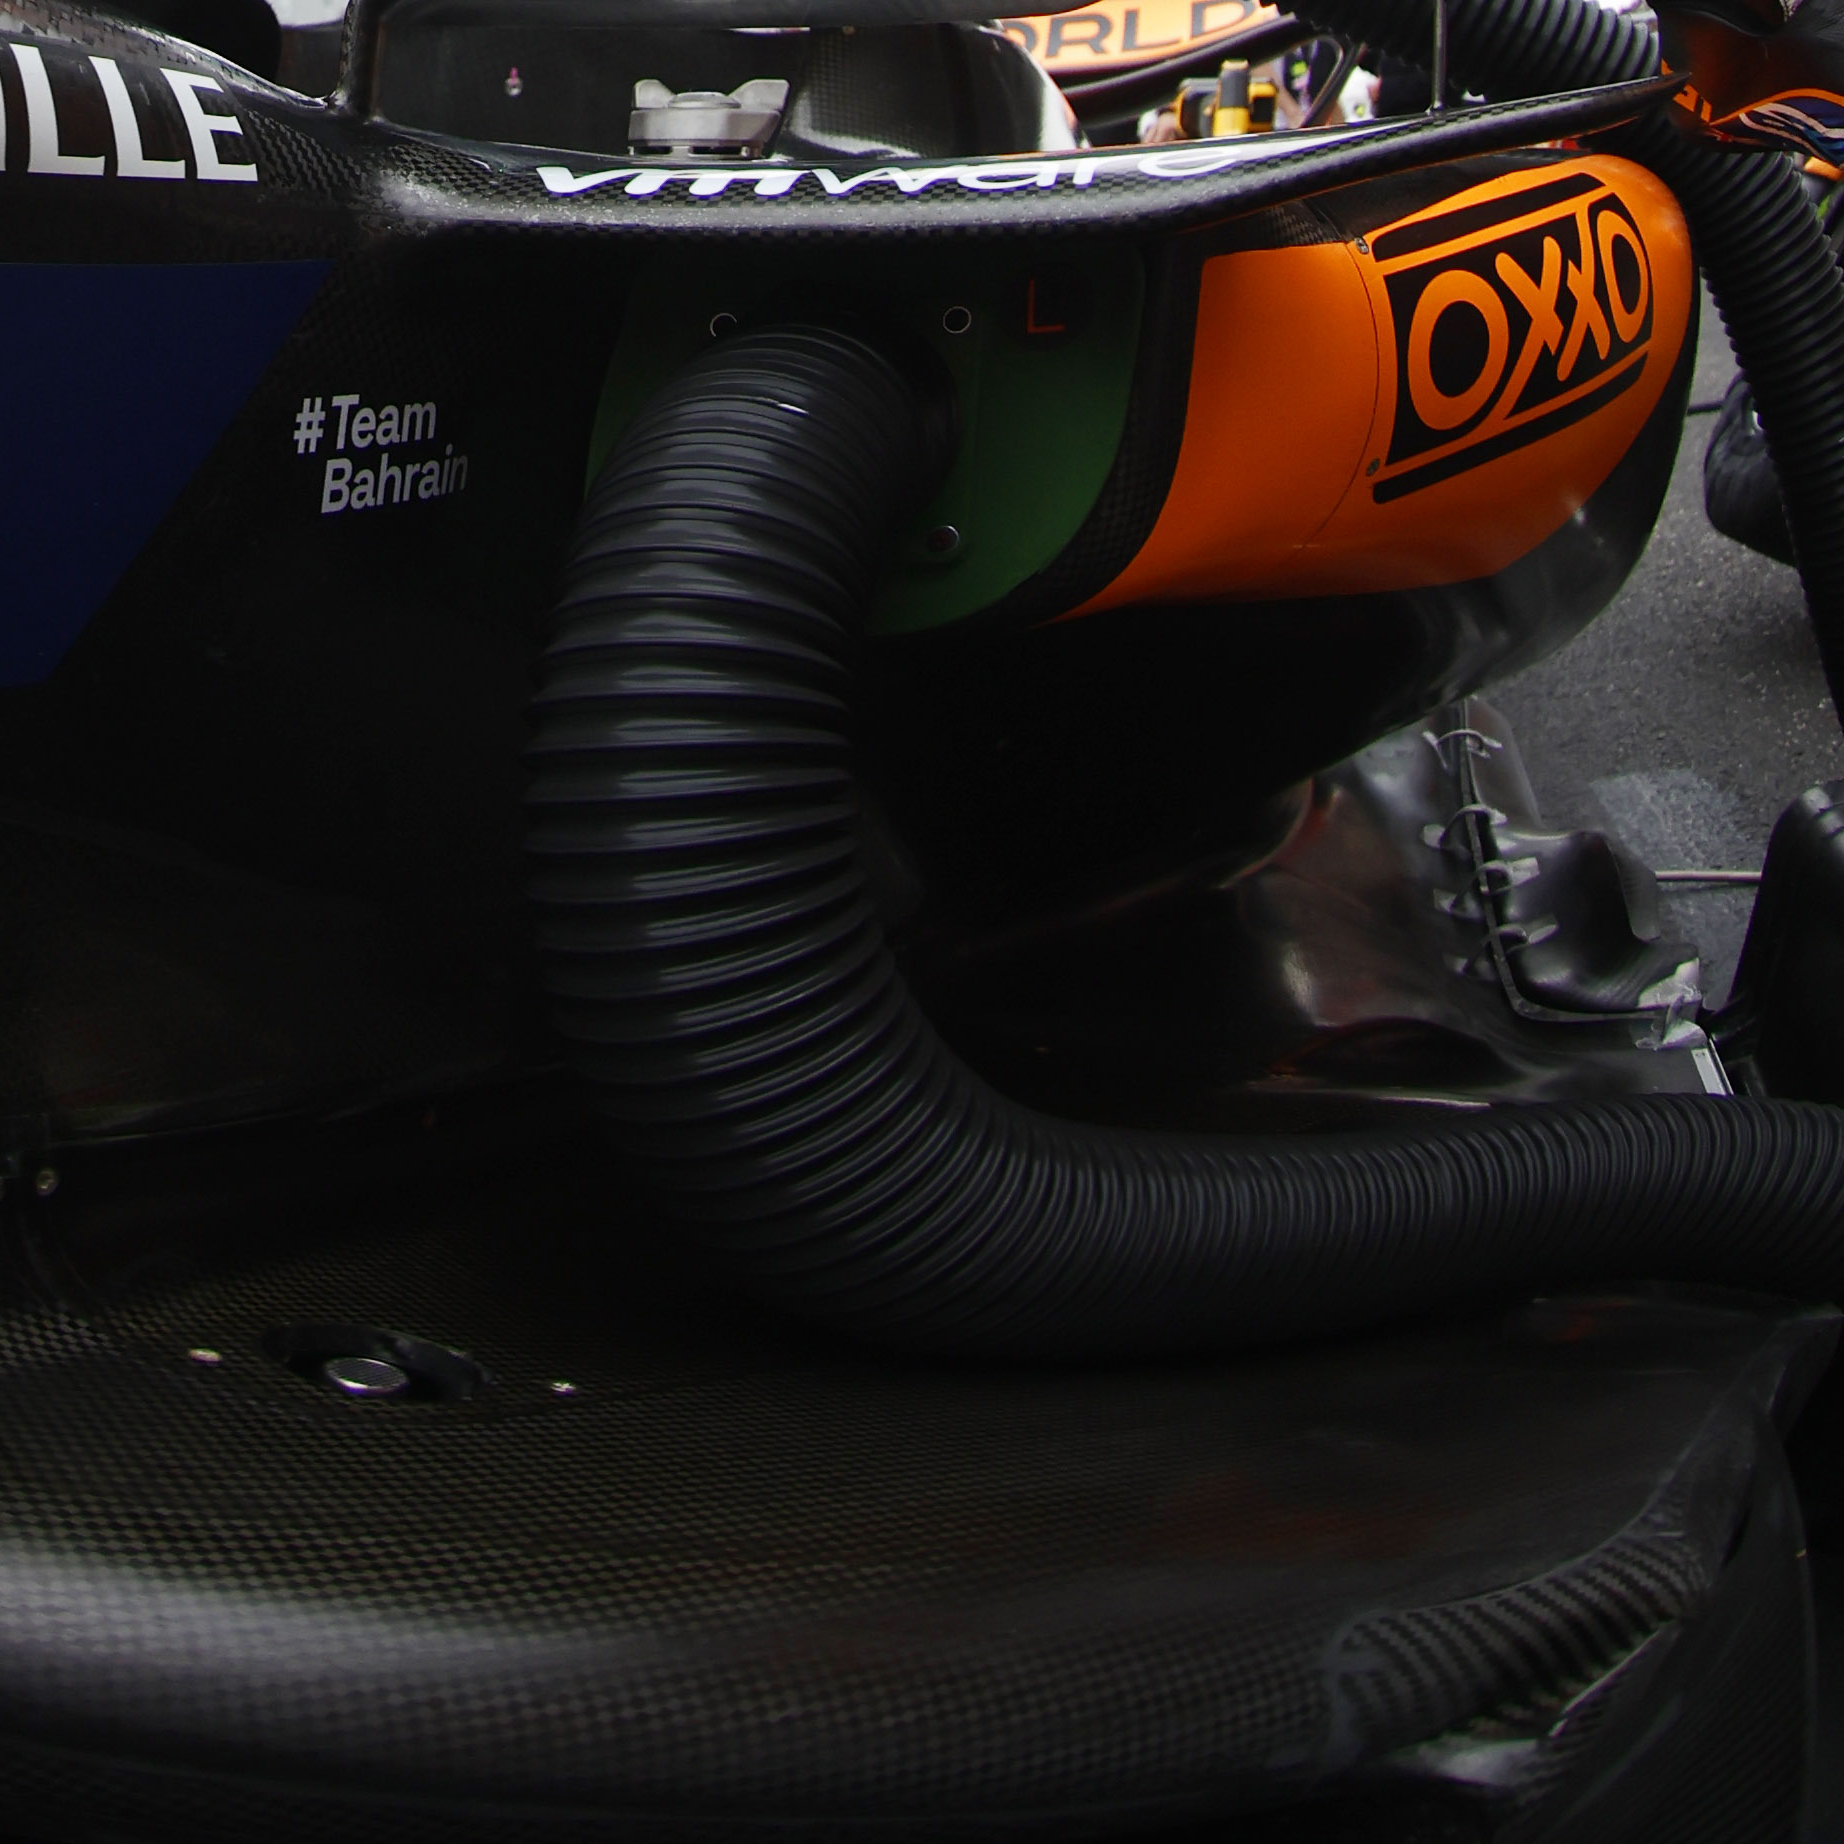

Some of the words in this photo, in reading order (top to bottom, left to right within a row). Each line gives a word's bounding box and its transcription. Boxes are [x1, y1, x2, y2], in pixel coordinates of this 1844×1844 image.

[535, 146, 1241, 197] vmware
[1407, 208, 1650, 432] OXXO
[292, 393, 438, 455] #Team
[320, 443, 469, 514] Bahrain
